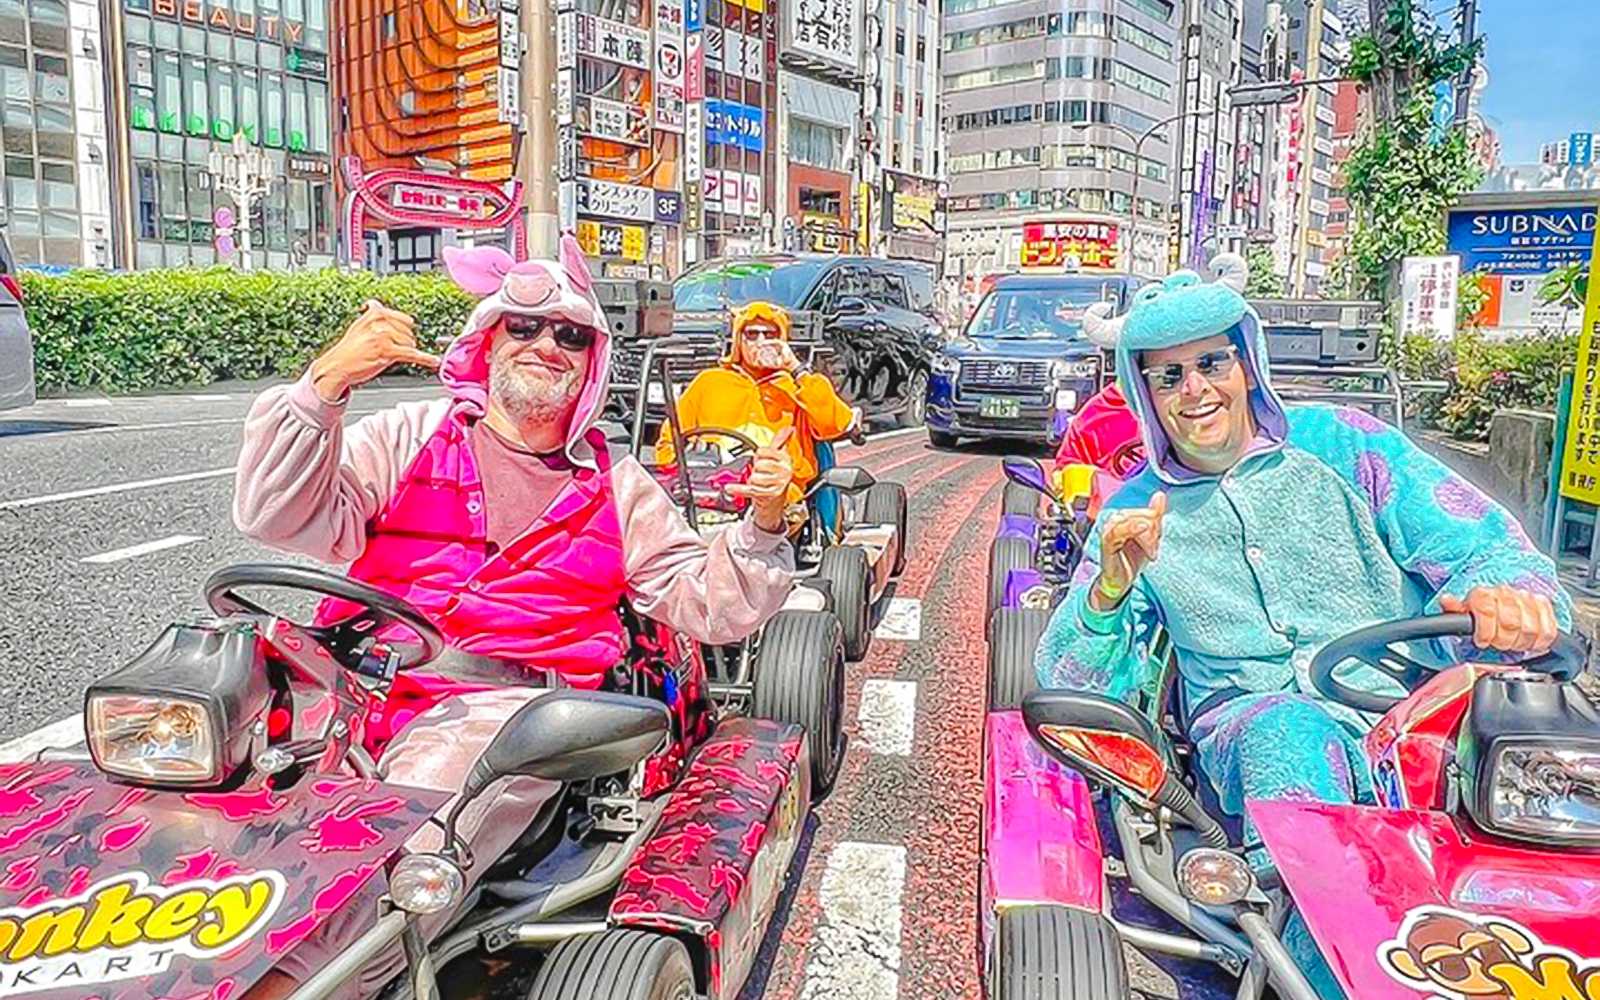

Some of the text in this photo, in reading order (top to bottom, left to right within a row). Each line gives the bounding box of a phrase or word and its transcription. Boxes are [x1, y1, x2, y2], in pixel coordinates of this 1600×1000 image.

[155, 0, 302, 42] BEAUTY
[705, 174, 758, 202] アコム
[591, 198, 638, 216] クリニック
[658, 197, 677, 215] 3F
[0, 948, 174, 987] KART
